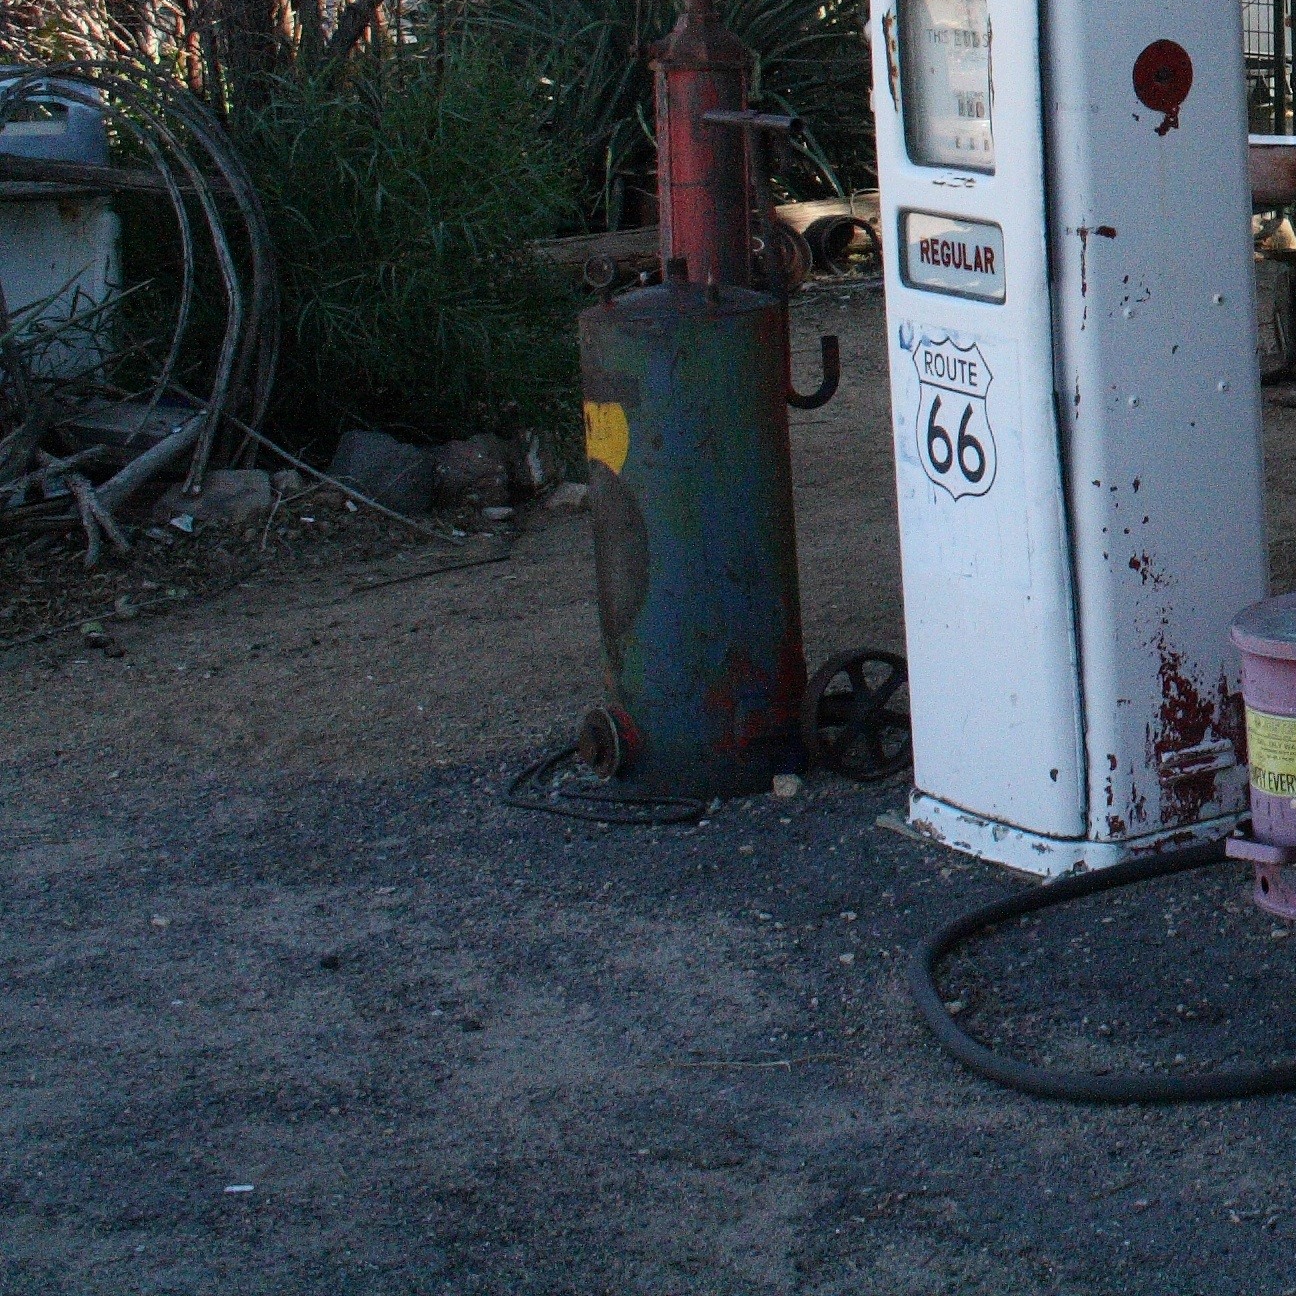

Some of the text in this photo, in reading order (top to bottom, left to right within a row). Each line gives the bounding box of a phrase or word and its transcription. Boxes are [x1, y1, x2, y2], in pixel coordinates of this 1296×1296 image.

[920, 237, 996, 275] REGULAR
[924, 350, 978, 387] ROUTE
[926, 394, 986, 484] 66
